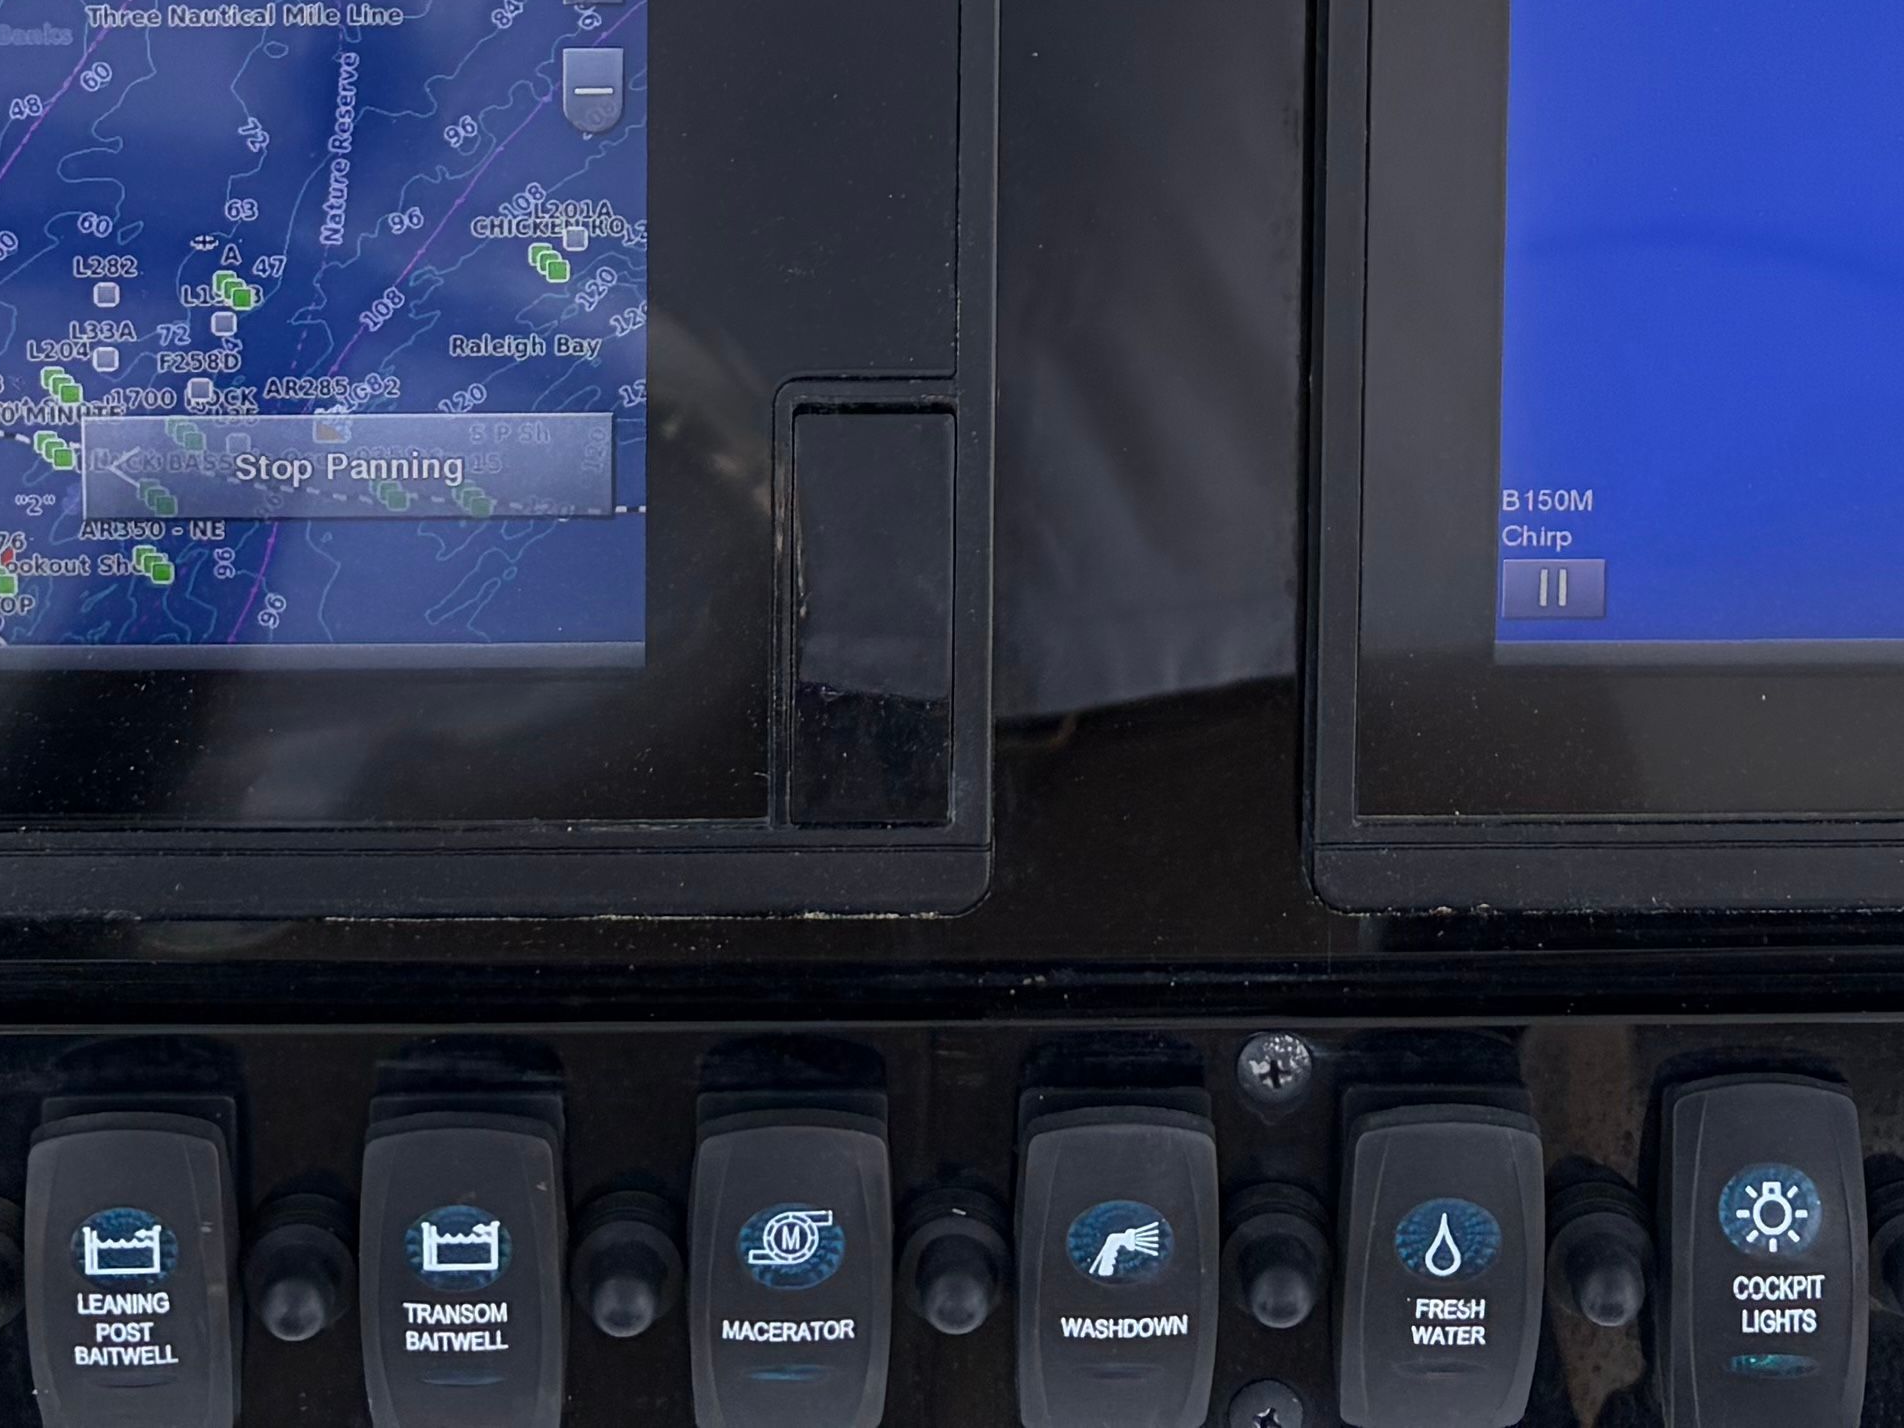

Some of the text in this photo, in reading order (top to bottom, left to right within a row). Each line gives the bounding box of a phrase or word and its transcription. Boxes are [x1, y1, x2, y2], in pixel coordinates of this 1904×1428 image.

[85, 4, 404, 27] Three Nautical Mile Line
[329, 52, 360, 155] Reserve
[321, 159, 350, 245] Nature
[73, 256, 137, 277] L282
[449, 334, 602, 360] Raleigh Bay
[235, 454, 313, 487] Stop
[327, 453, 464, 485] Panning
[1502, 489, 1593, 512] B150M
[1501, 524, 1573, 553] Chirp
[1732, 1273, 1825, 1301] COCKPIT
[76, 1291, 171, 1315] LEANING
[403, 1301, 508, 1325] TRANSOM
[1415, 1298, 1486, 1322] FRESH
[721, 1318, 856, 1342] MACERATOR
[1060, 1314, 1189, 1340] WASHDOWN
[1741, 1307, 1817, 1334] LIGHTS
[96, 1322, 154, 1344] POST
[405, 1330, 510, 1353] BAITWELL
[1411, 1324, 1486, 1347] WATER
[74, 1344, 179, 1367] BAITWELL
